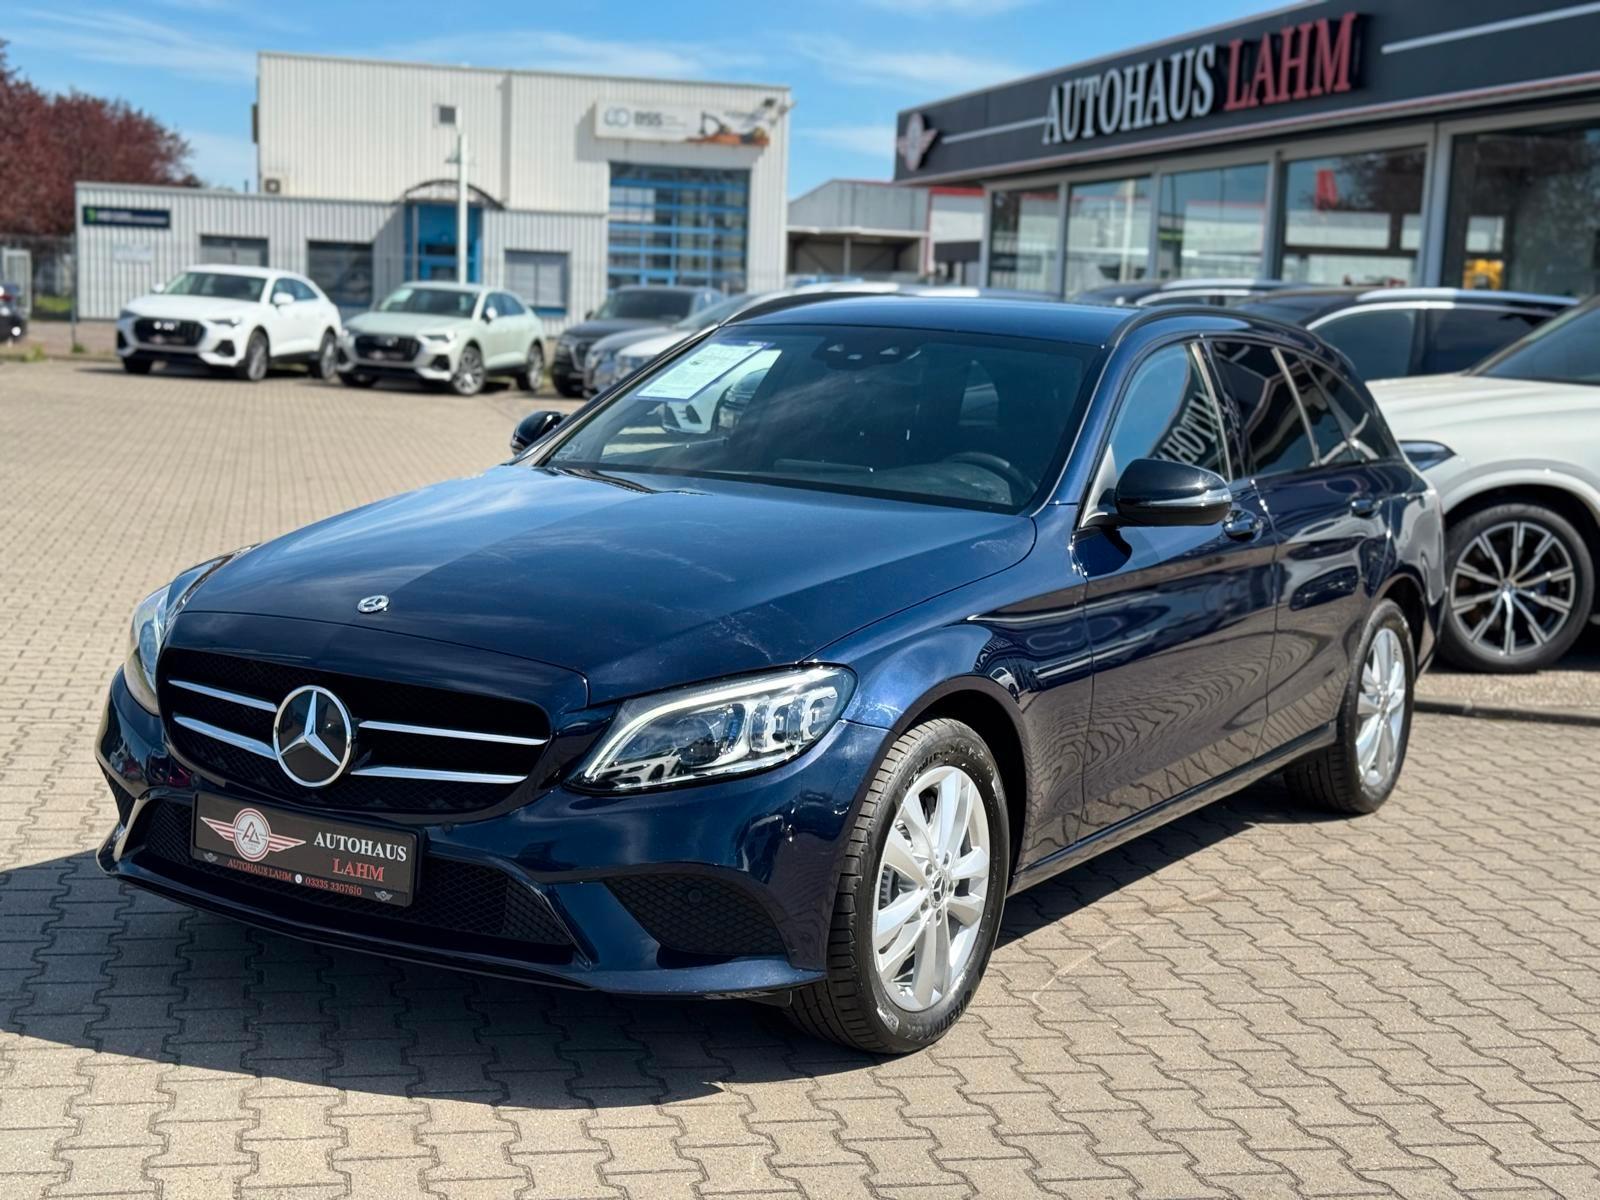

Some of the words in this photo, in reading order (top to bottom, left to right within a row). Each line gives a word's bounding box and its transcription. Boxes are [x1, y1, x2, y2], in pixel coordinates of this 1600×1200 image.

[1042, 44, 1215, 145] AUTOHAUS
[1225, 12, 1357, 111] LAHM
[314, 832, 407, 862] AUTOHAUS
[227, 858, 268, 876] AUTOHAUS
[268, 868, 292, 882] LAHM
[305, 877, 328, 890] 03335
[332, 858, 384, 882] LAHM
